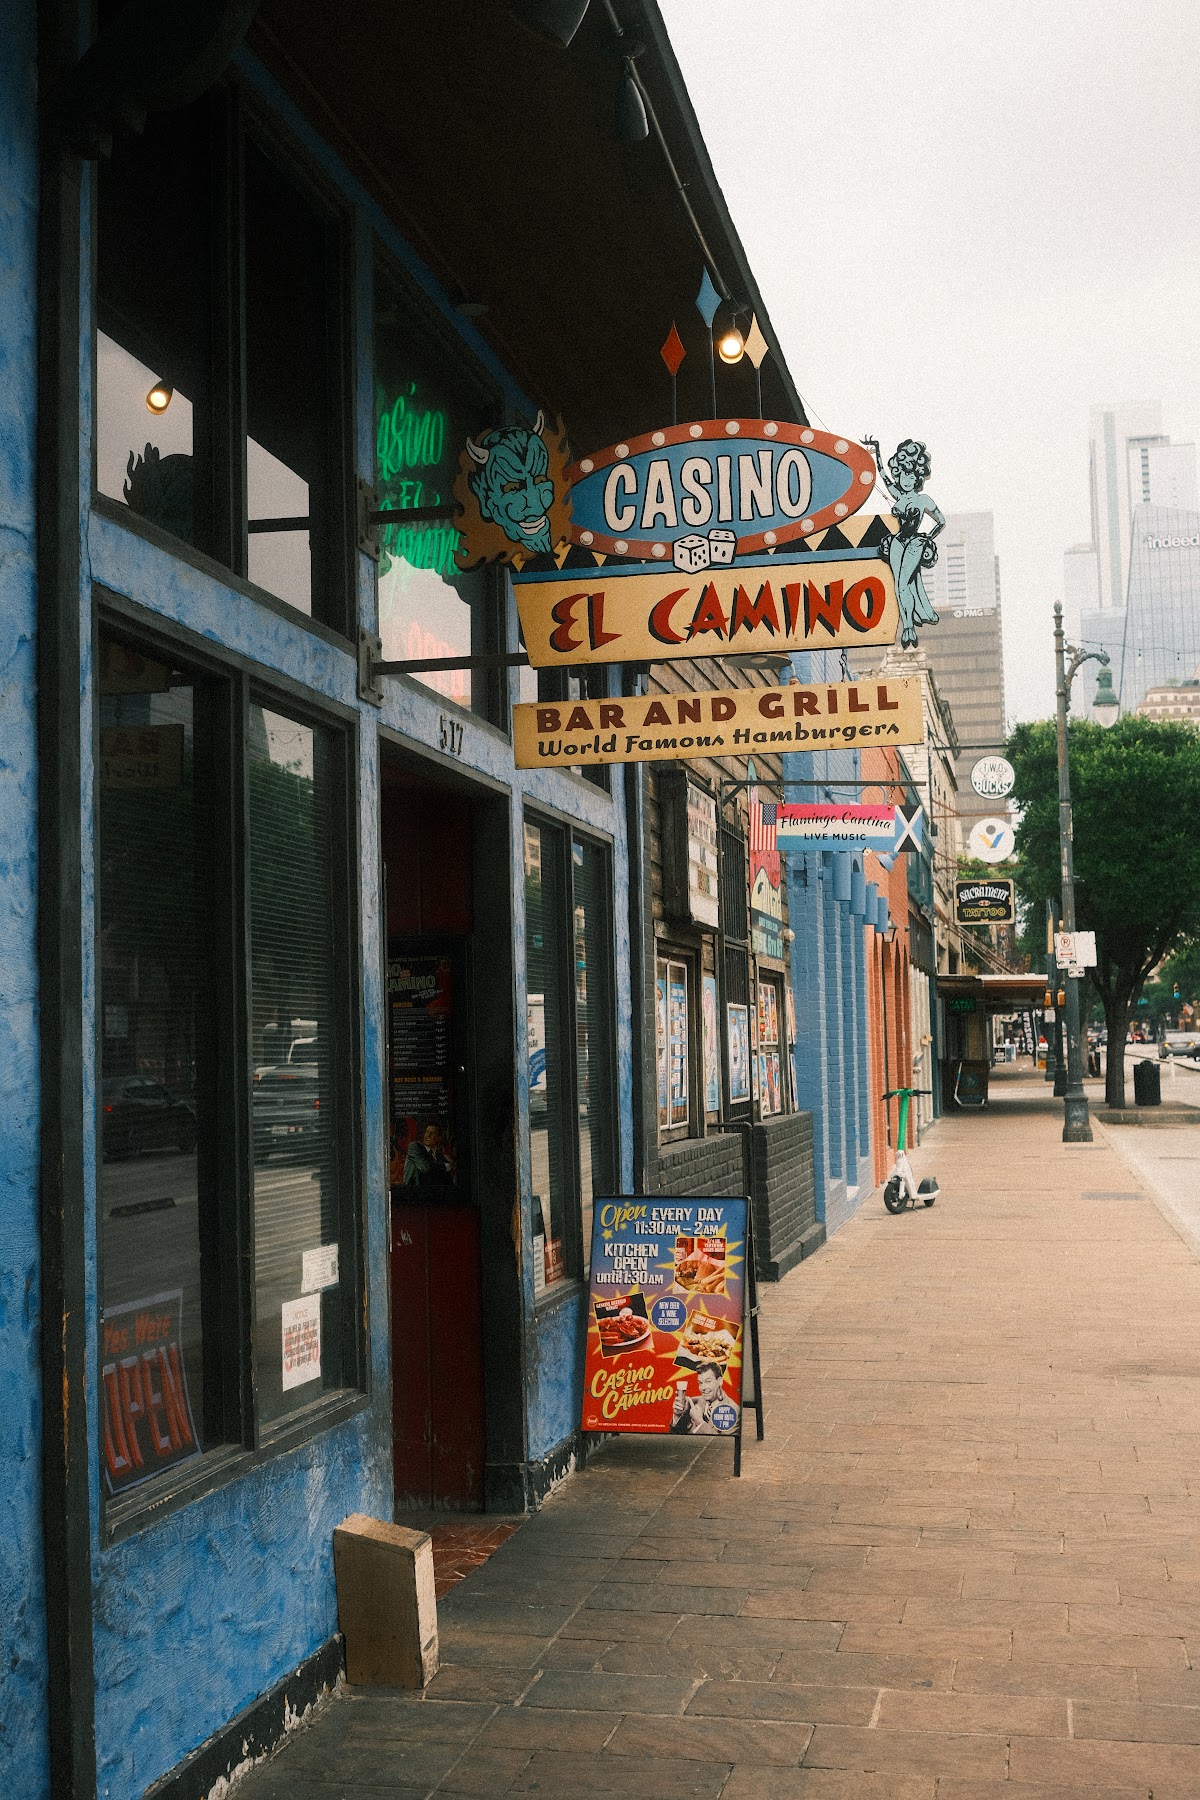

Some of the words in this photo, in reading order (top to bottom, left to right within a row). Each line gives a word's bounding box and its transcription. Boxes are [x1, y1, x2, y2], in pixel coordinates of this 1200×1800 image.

[603, 449, 813, 532] CASINO
[1147, 533, 1200, 549] indeed
[550, 592, 623, 652] EL
[648, 576, 886, 645] CAMINO
[963, 608, 983, 618] PMG
[536, 704, 626, 734] BAR
[643, 696, 738, 727] AND
[758, 685, 899, 719] GRILL
[440, 714, 463, 756] 517
[537, 734, 617, 757] World
[625, 733, 725, 754] Famous
[733, 721, 900, 745] Hamburgers
[984, 763, 1004, 773] TWO
[976, 779, 1009, 793] BUCKS
[780, 813, 838, 829] Flamingo
[842, 811, 891, 830] Cantina
[804, 833, 828, 841] LIVE
[832, 833, 867, 841] MUSIC
[959, 885, 1010, 903] SACRAMENT
[963, 907, 1006, 917] TATTOO
[601, 1204, 647, 1231] Open
[651, 1207, 692, 1221] EVERY
[697, 1207, 723, 1221] DAY
[604, 1243, 658, 1257] KITCHEN
[614, 1257, 648, 1270] OPEN
[596, 1270, 622, 1284] until
[658, 1317, 680, 1326] SELECTION
[103, 1342, 193, 1477] OPEN
